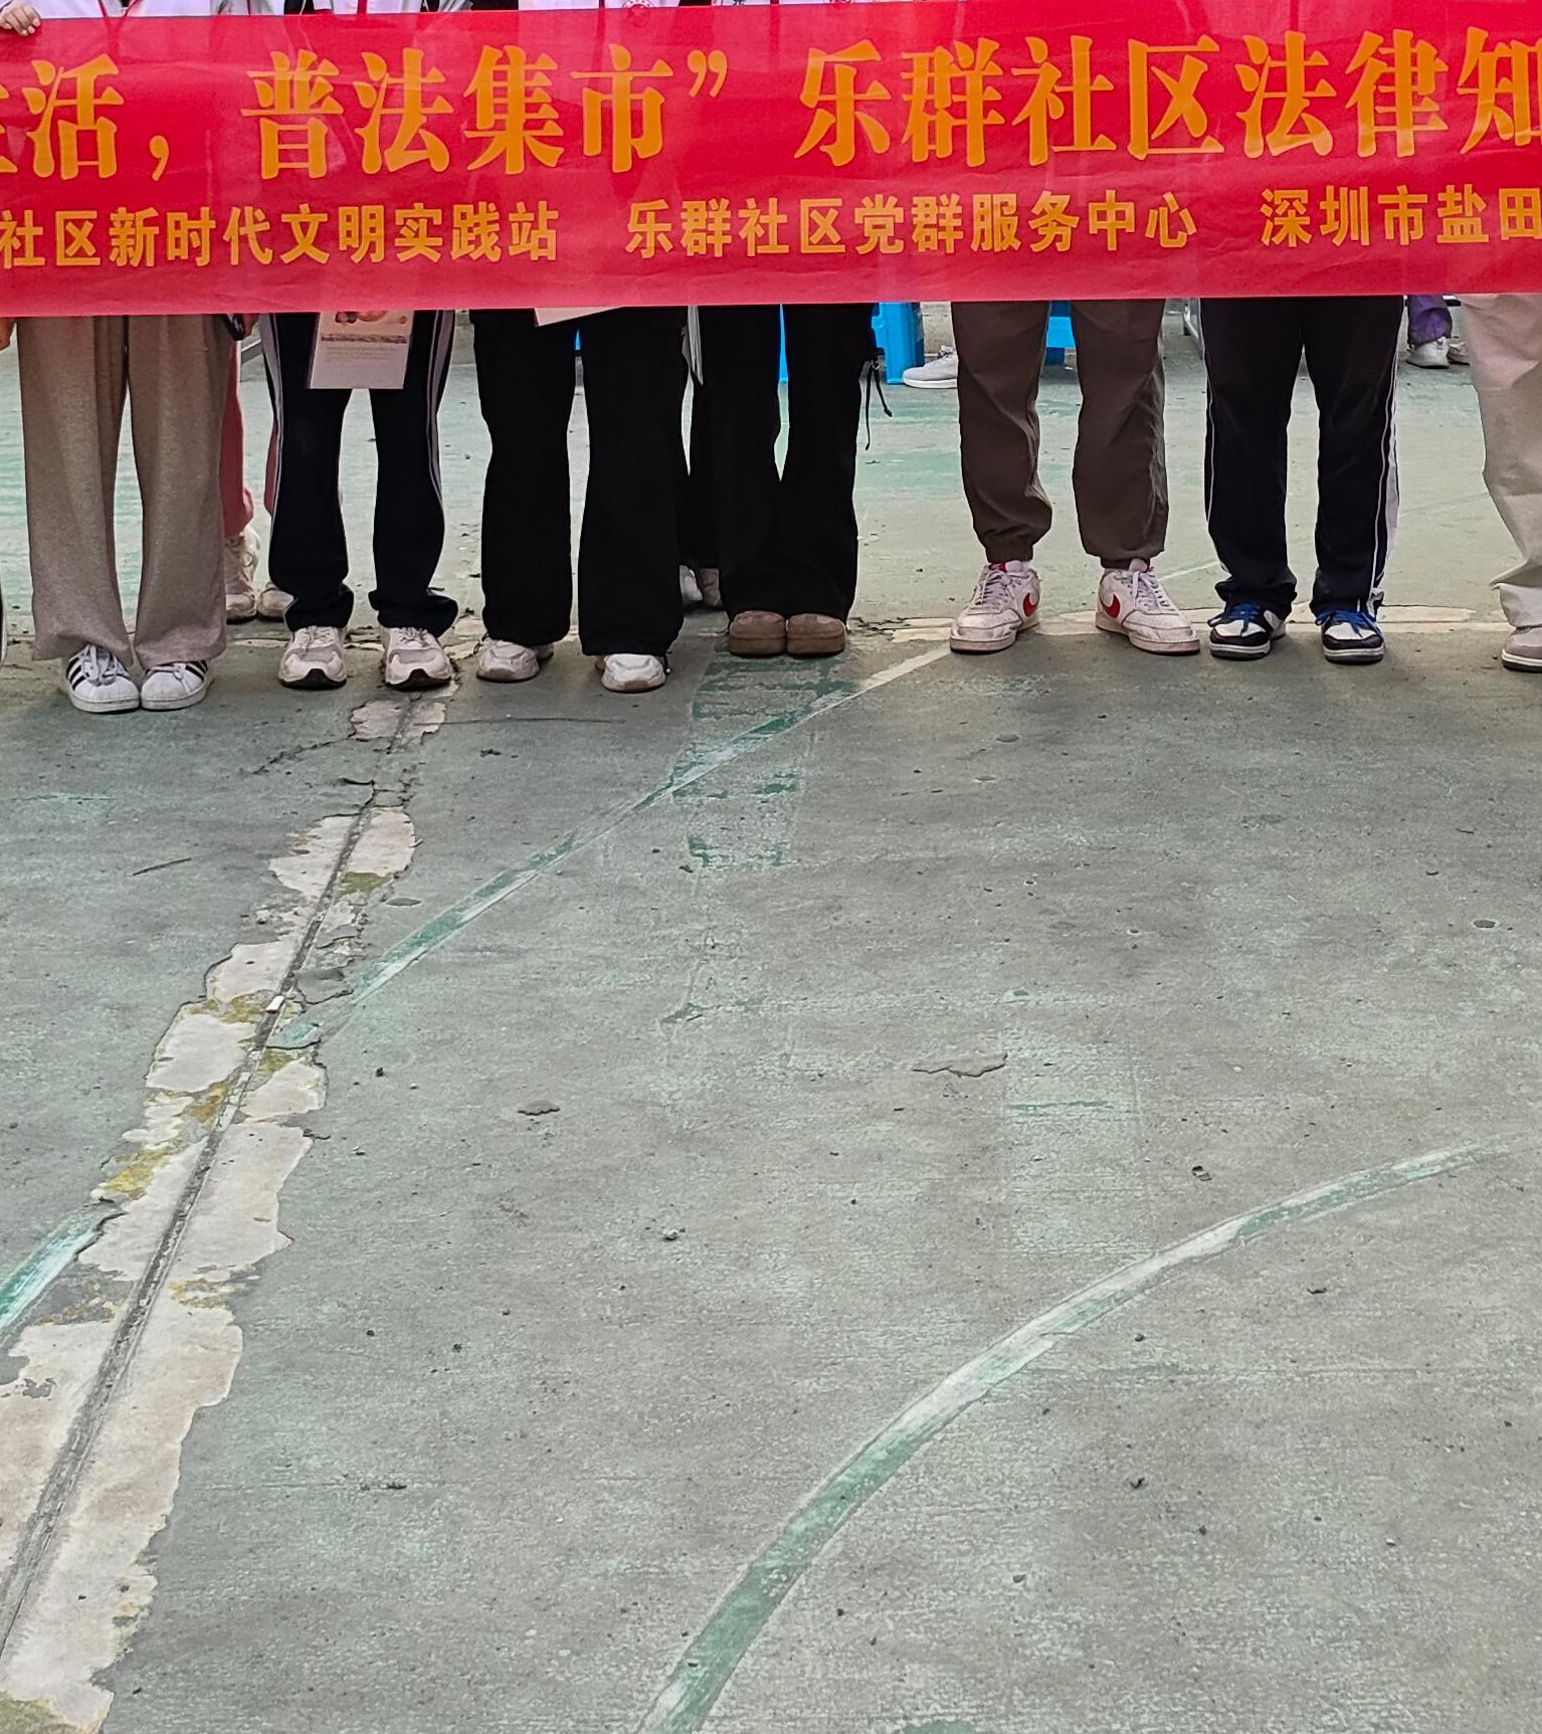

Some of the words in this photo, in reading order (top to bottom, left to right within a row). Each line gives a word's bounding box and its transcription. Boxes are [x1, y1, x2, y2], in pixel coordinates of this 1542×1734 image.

[626, 190, 1197, 258] 乐群社区党群服务中心
